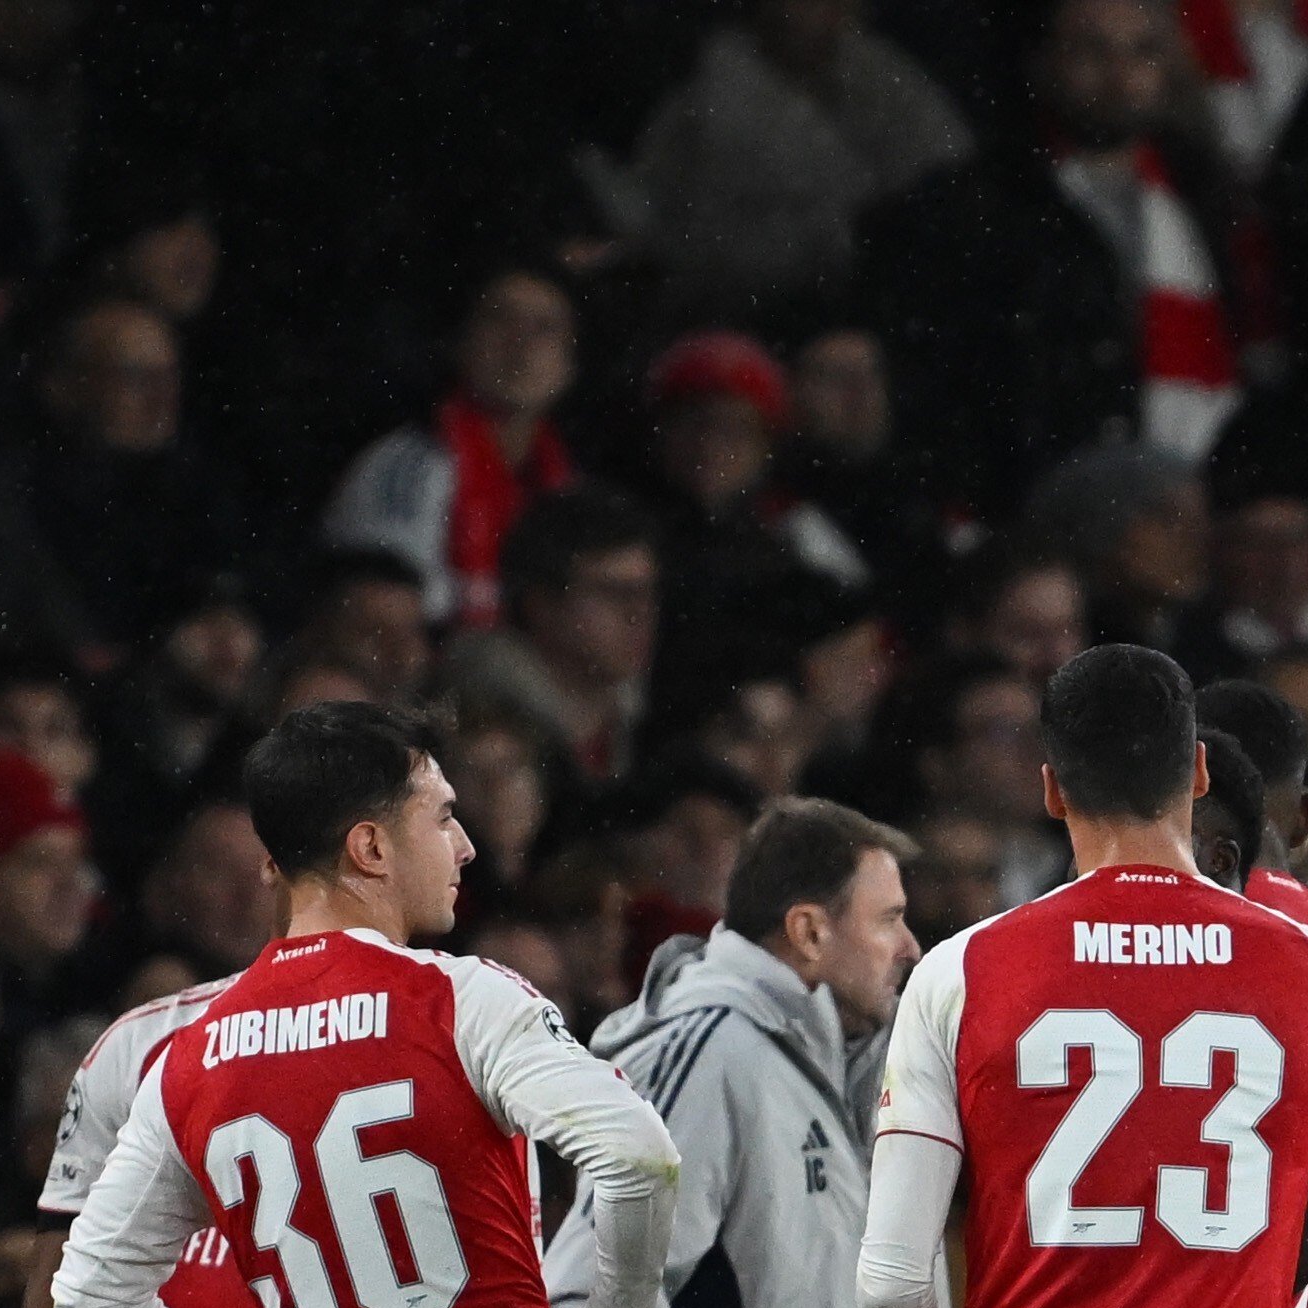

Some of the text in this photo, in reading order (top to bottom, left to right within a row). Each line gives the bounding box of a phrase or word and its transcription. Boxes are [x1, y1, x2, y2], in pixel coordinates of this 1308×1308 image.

[1114, 871, 1179, 885] Arsenal
[271, 937, 327, 965] Arsenal
[1073, 922, 1233, 966] MERINO
[202, 991, 389, 1071] ZUBIMENDI
[1015, 1008, 1286, 1253] 23
